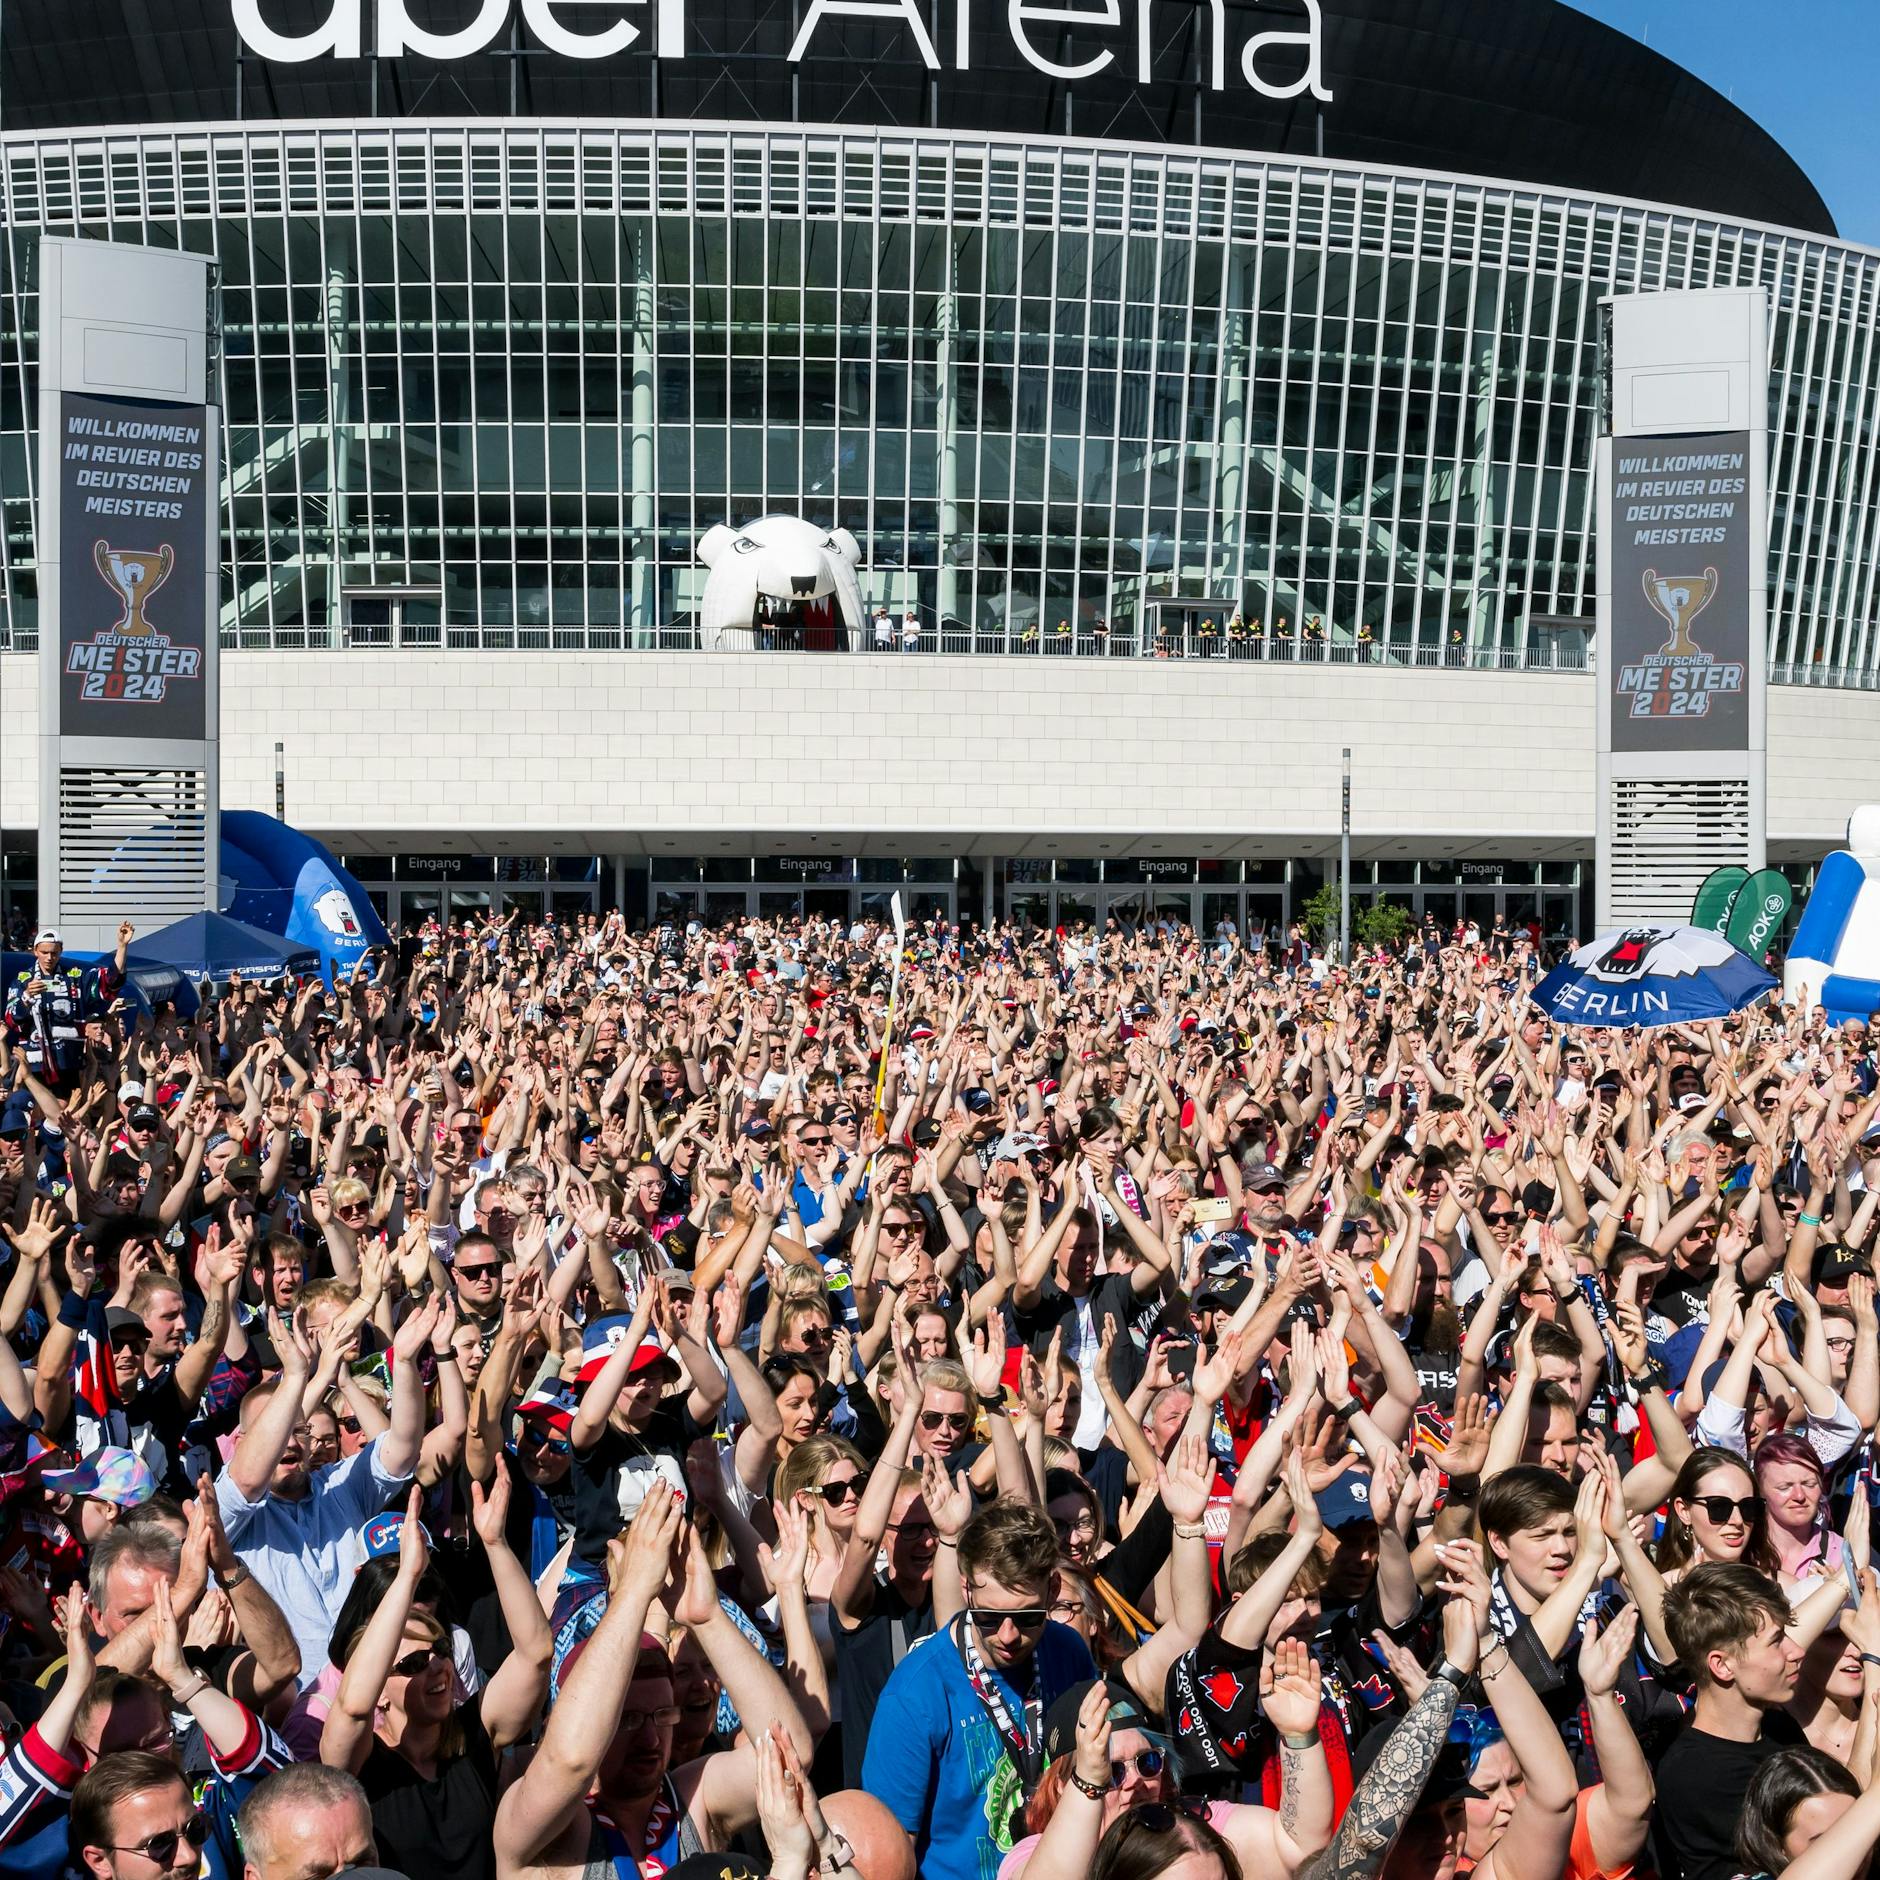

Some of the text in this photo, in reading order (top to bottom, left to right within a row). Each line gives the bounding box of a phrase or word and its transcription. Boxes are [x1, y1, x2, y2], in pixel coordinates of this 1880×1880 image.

[68, 416, 200, 444] WILLKOMMEN
[65, 443, 202, 470] IM REVIER DES
[1619, 453, 1743, 475] WILLKOMMEN
[76, 469, 192, 495] DEUTSCHEN
[1616, 478, 1746, 499] IM REVIER DES
[85, 496, 183, 520] MEISTERS
[1626, 502, 1735, 522] DEUTSCHEN
[1634, 527, 1727, 546] MEISTERS
[95, 634, 169, 648] DEUTSCHER
[69, 645, 199, 676] MEISTER
[1644, 655, 1712, 667] DEUTSCHER
[84, 672, 165, 699] 2024
[1620, 665, 1741, 691] MEISTER
[1633, 690, 1709, 715] 2024
[408, 857, 461, 871] Eingang
[780, 858, 832, 872] Eingang
[1139, 860, 1188, 873] Eingang
[1461, 862, 1504, 875] Eingang
[1713, 906, 1730, 938] OK
[1748, 910, 1776, 951] AOK
[237, 964, 282, 974] GASAG
[1551, 982, 1669, 1016] BERLIN
[1190, 1707, 1208, 1737] LIGO
[1202, 1738, 1220, 1769] LIGO
